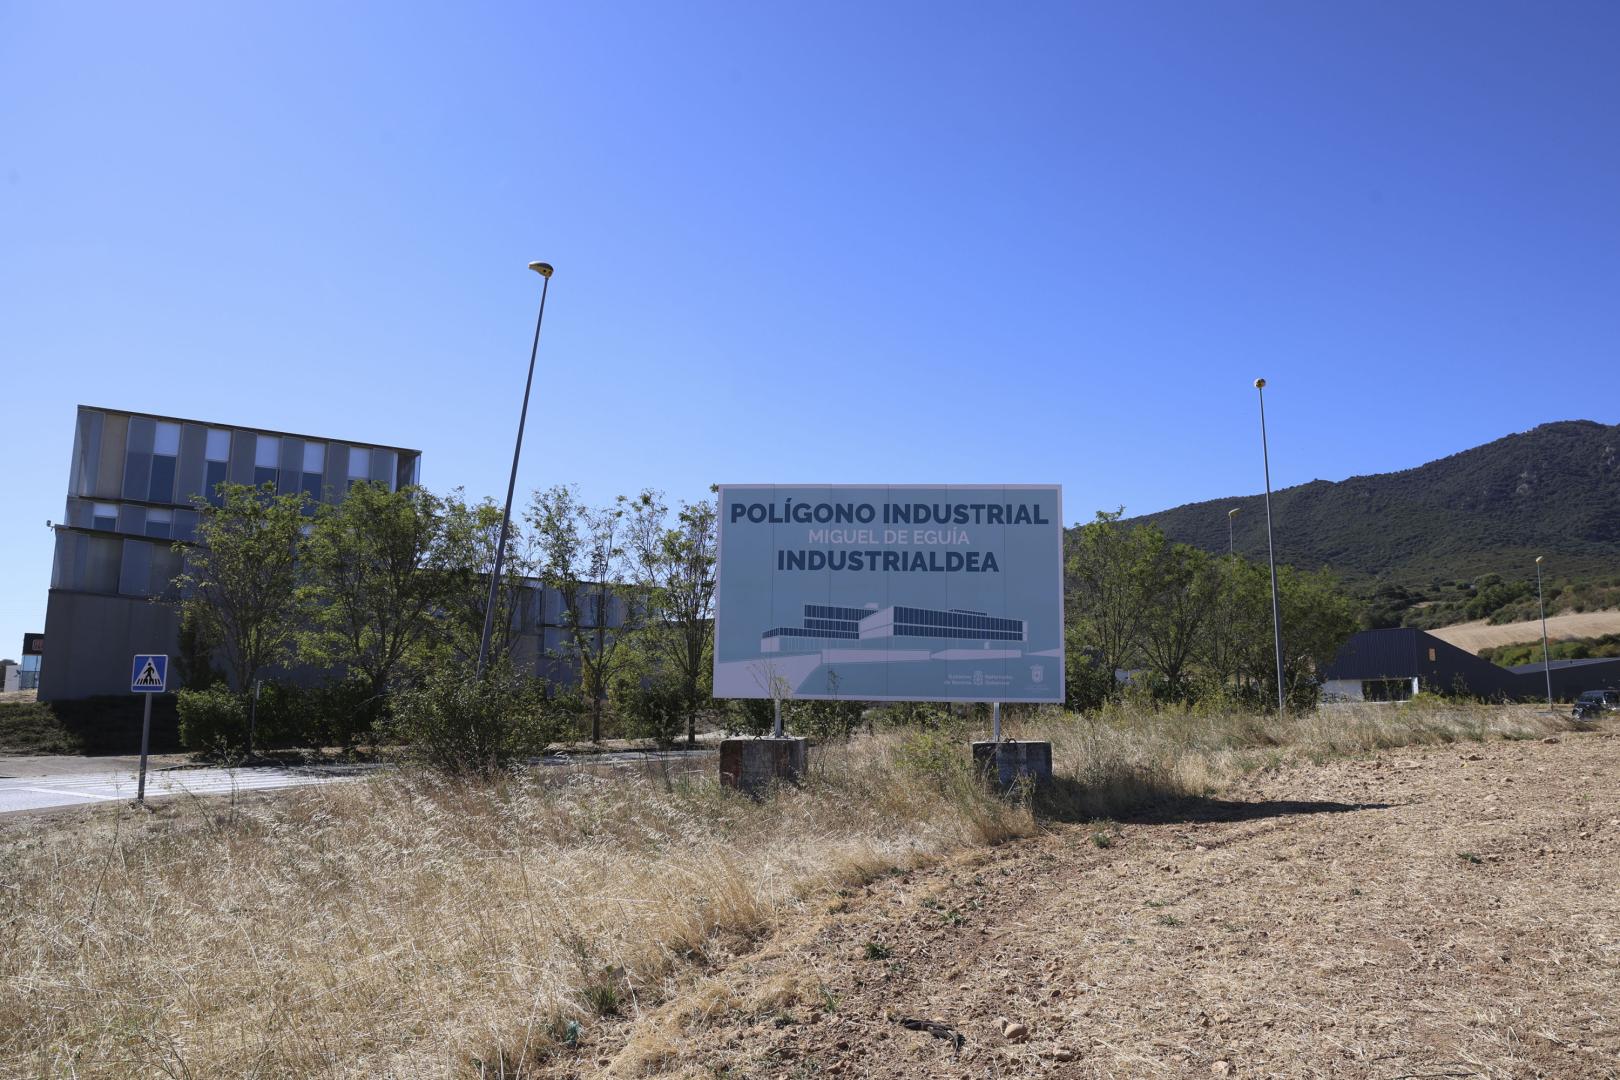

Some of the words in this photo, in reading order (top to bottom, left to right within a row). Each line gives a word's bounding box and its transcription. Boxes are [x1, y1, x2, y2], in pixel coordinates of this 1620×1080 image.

[731, 497, 875, 524] POLÍGONO
[883, 503, 1049, 525] INDUSTRIAL
[808, 529, 880, 545] MIGUEL
[884, 529, 908, 545] DE
[914, 528, 970, 546] EGUÍA
[777, 550, 1000, 573] INDUSTRIALDEA
